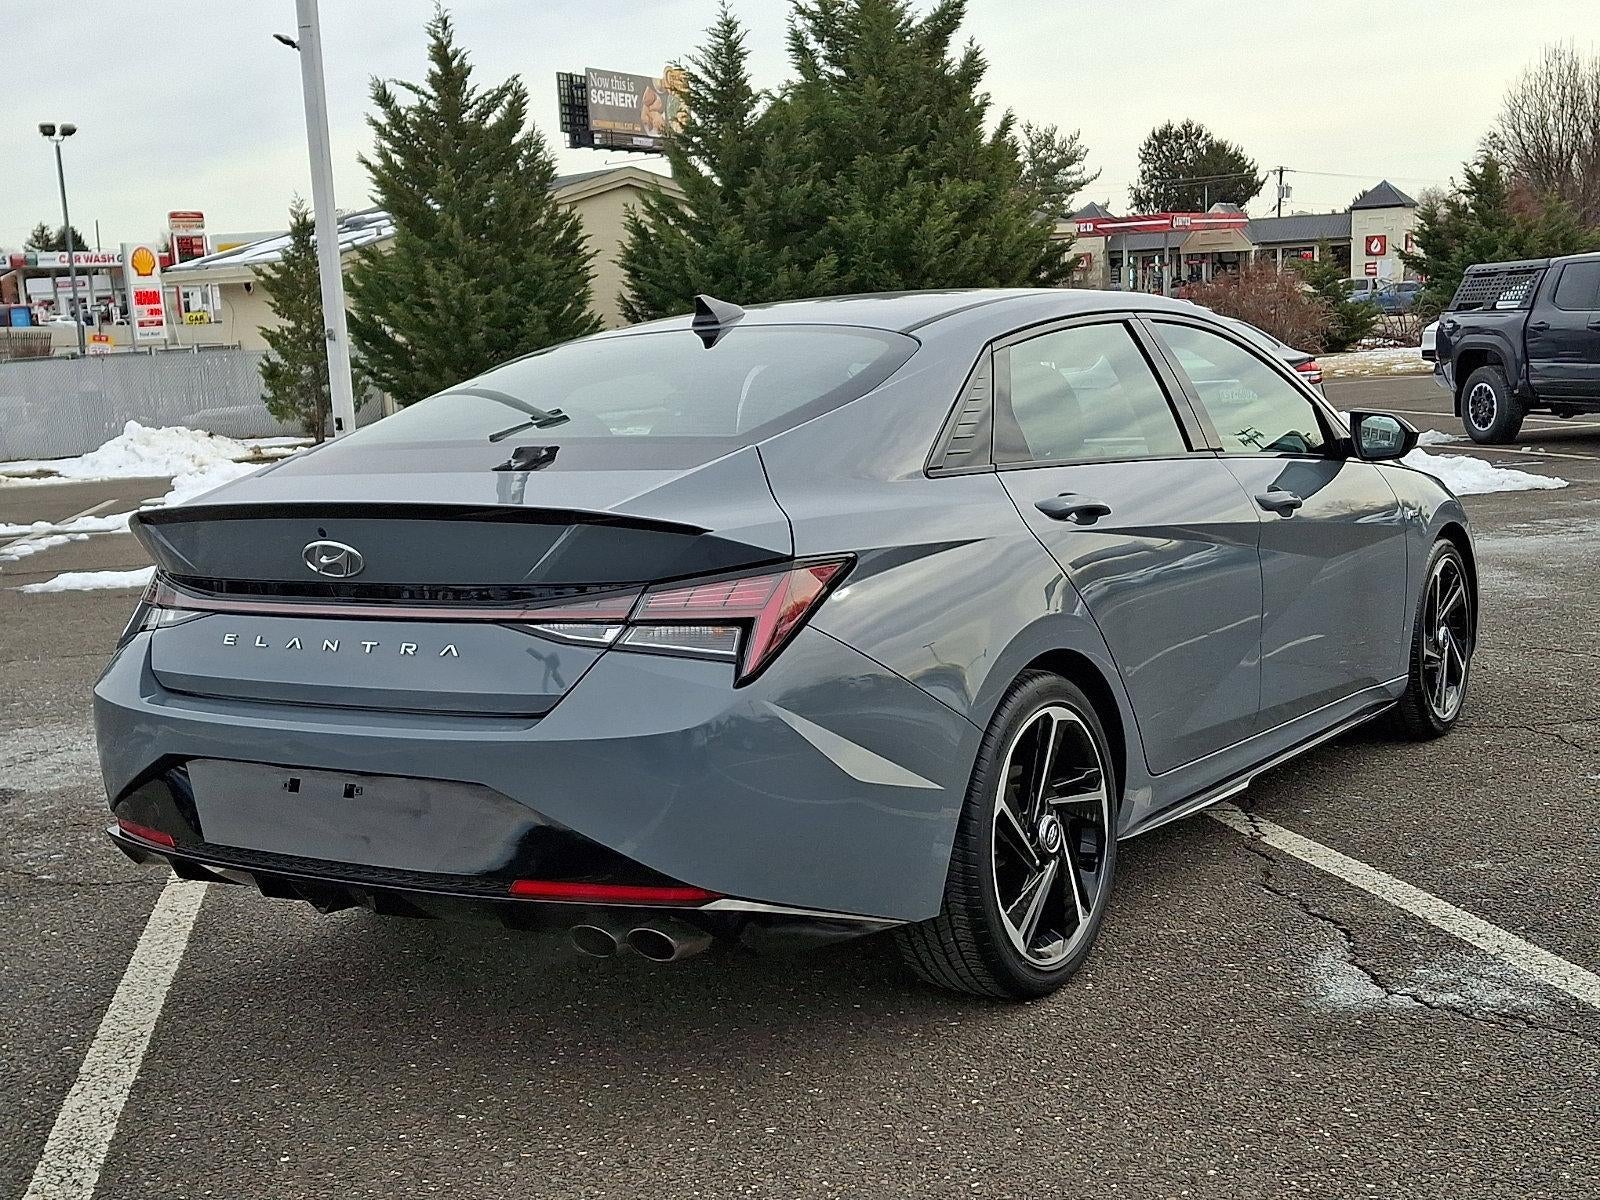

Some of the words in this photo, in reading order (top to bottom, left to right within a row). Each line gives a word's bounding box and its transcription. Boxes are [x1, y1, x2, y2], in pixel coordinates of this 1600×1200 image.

[590, 71, 610, 88] Now
[611, 75, 626, 90] this
[627, 77, 634, 92] is
[590, 89, 638, 108] SCENERY
[84, 254, 115, 263] WASH
[223, 633, 459, 658] ELANTRA
